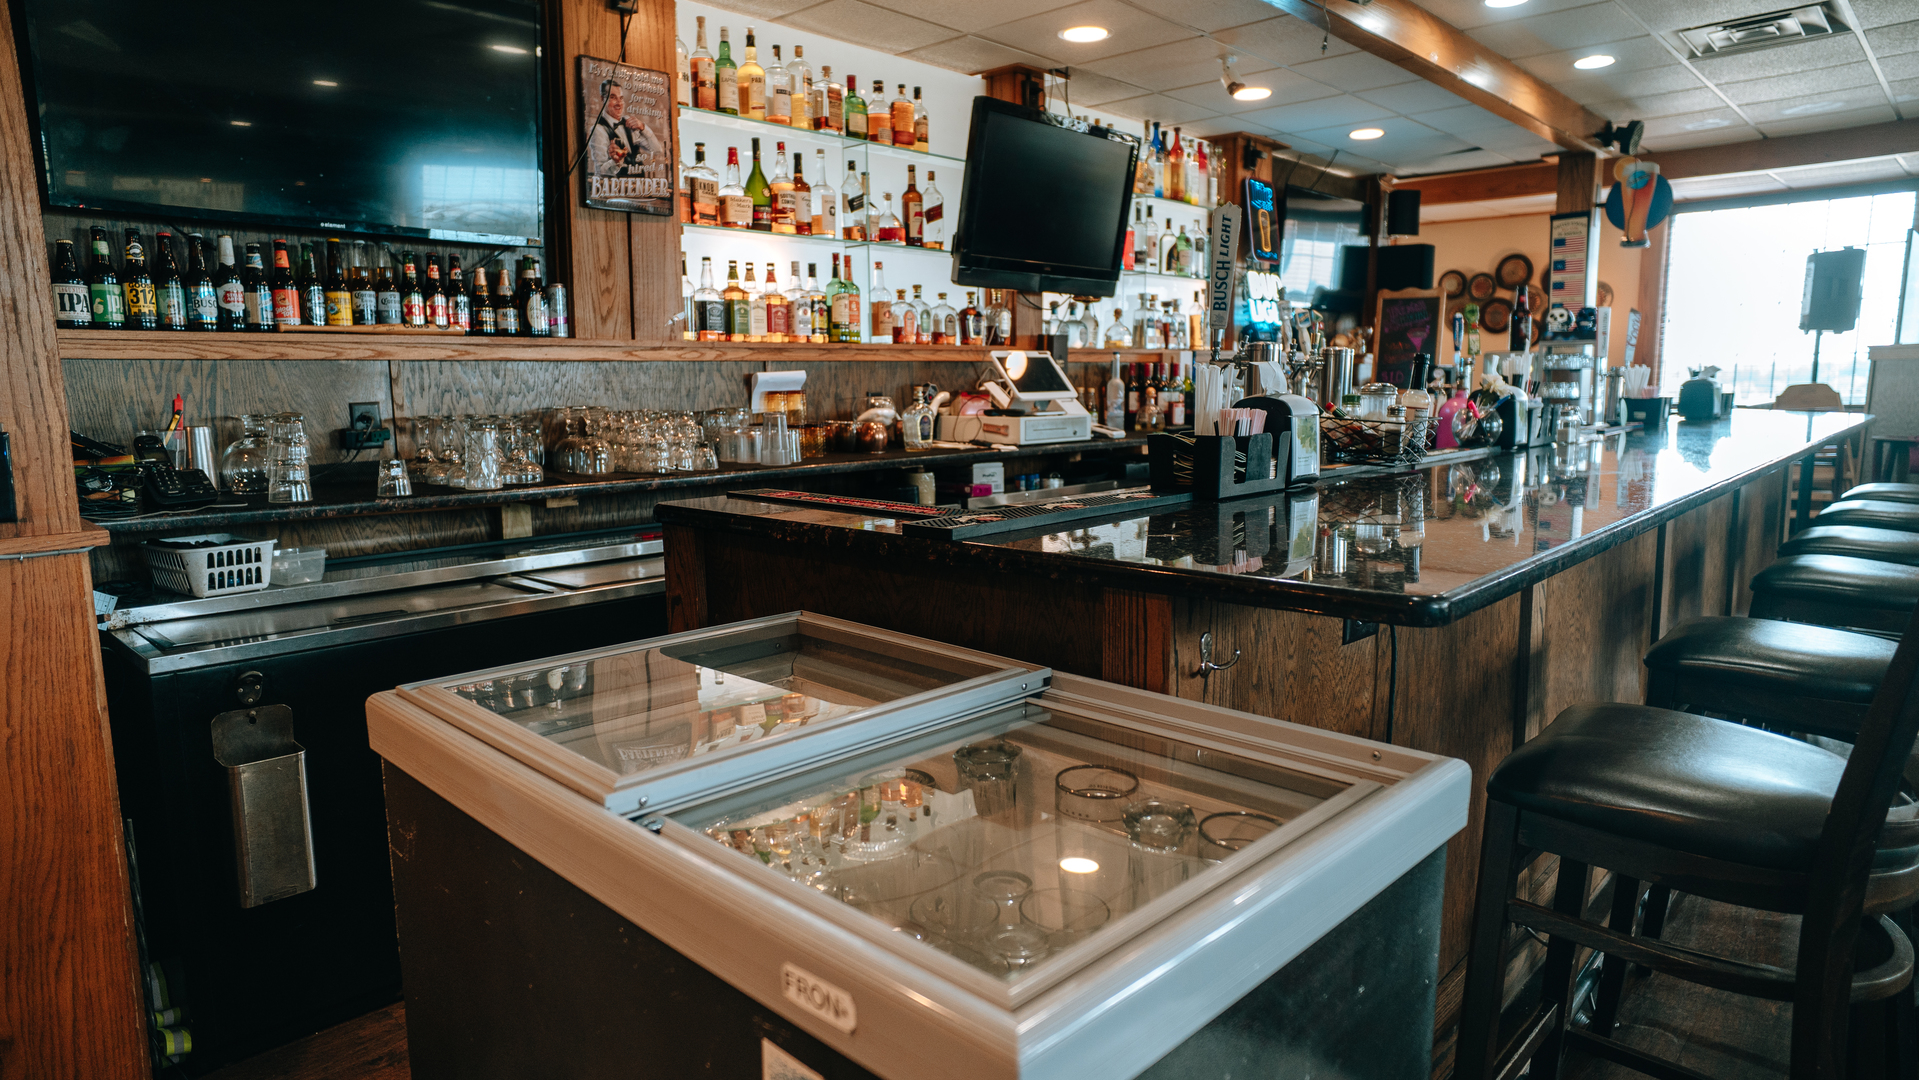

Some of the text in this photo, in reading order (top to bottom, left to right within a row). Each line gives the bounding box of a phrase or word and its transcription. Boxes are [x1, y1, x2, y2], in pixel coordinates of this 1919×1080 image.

[589, 63, 601, 76] My
[633, 71, 649, 83] told
[651, 75, 664, 85] me
[624, 81, 665, 96] to get help
[629, 93, 657, 106] for my
[635, 153, 648, 162] so
[627, 162, 665, 175] hired a
[699, 182, 714, 193] KNOB
[1213, 214, 1232, 311] BUSCH LIGHT
[57, 293, 90, 312] IPA
[129, 289, 156, 305] 312
